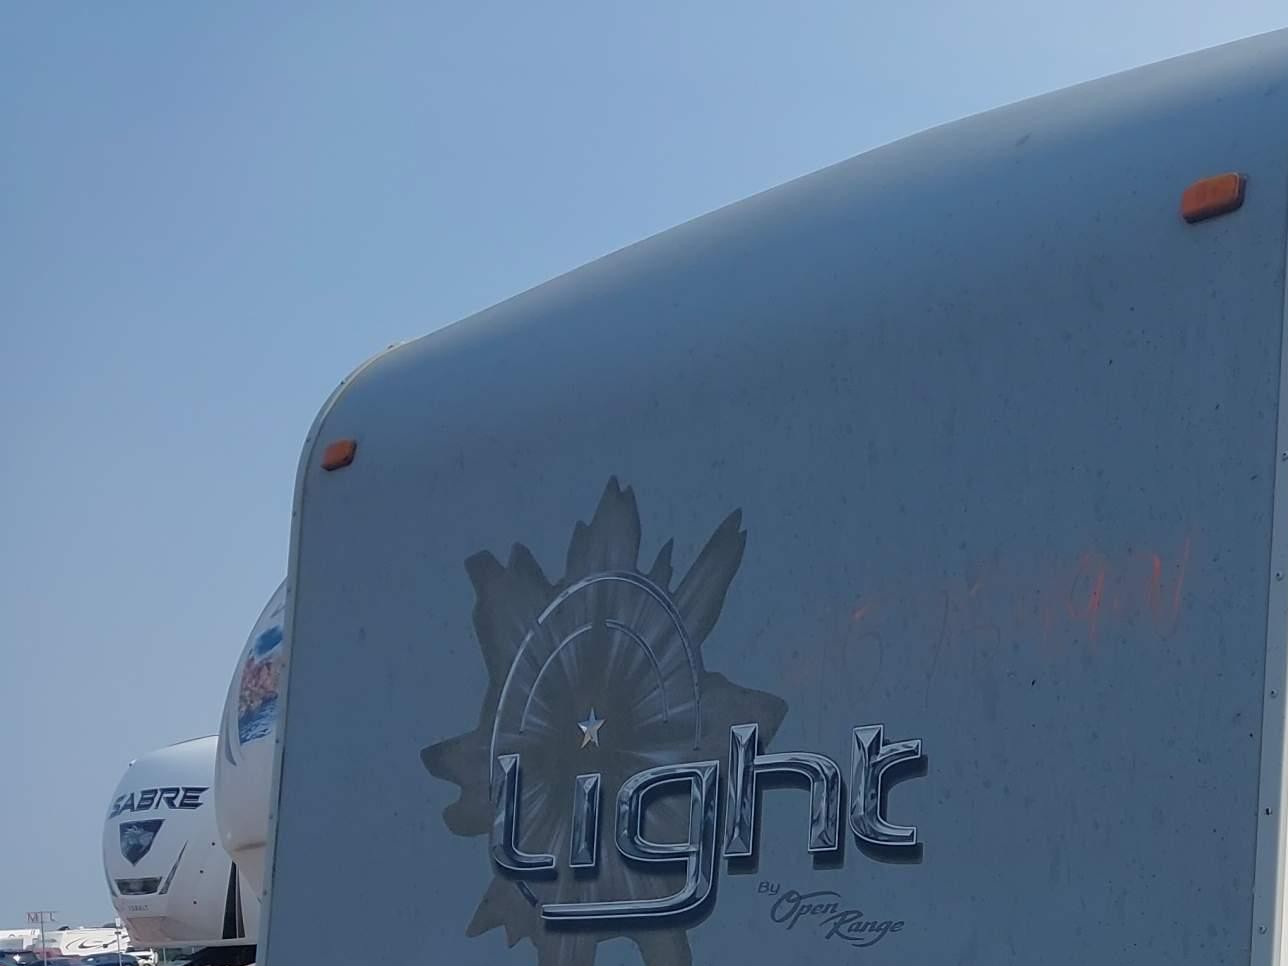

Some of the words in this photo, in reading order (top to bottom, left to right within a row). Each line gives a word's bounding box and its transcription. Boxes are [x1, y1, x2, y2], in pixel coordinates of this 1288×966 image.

[108, 786, 210, 819] SABRE
[494, 722, 926, 924] Light
[758, 881, 781, 895] By
[770, 889, 841, 930] Open
[819, 910, 905, 947] Range
